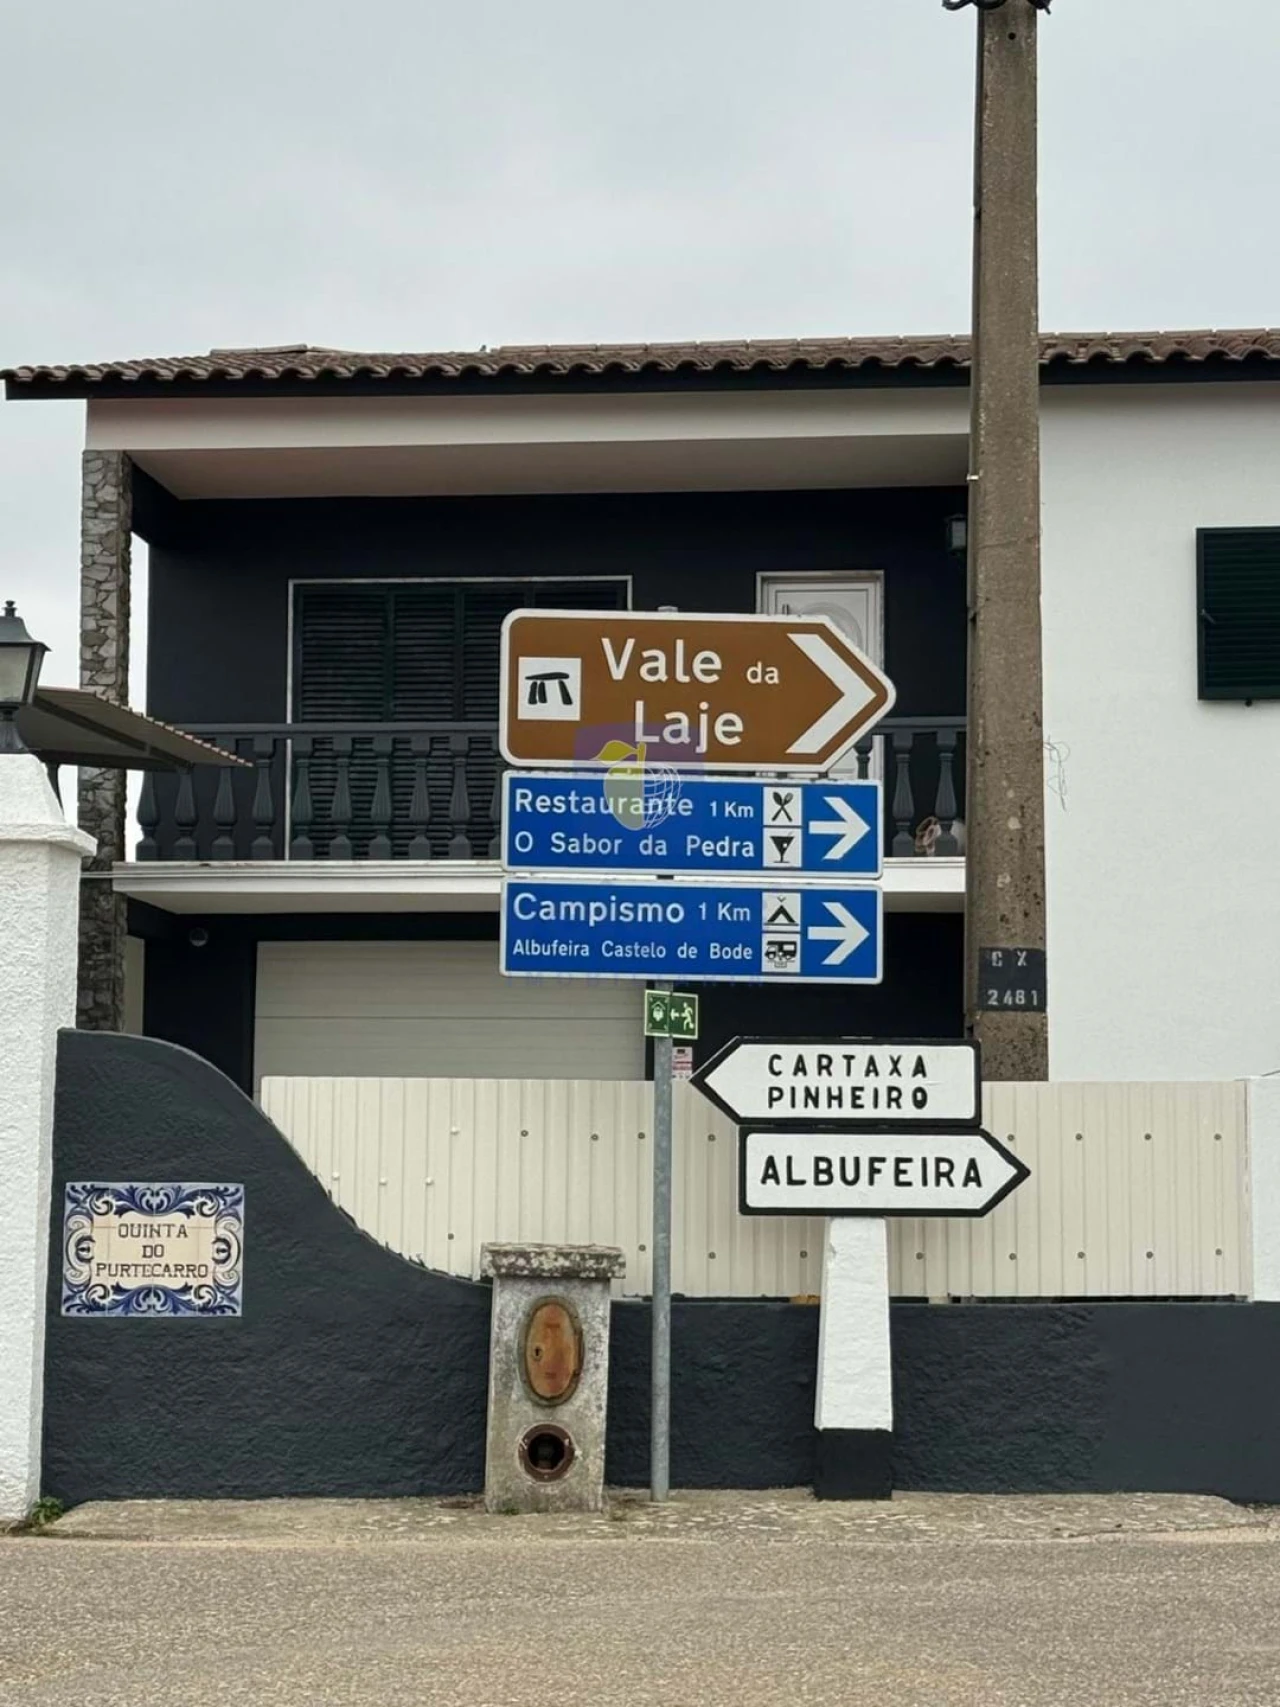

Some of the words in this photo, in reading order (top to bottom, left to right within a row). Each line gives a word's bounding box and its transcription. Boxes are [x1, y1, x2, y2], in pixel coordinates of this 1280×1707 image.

[601, 637, 723, 684] Vale
[746, 661, 780, 684] da
[634, 700, 744, 754] Laje
[514, 788, 694, 816] Restaurante
[709, 801, 718, 818] 1
[724, 802, 754, 819] Km
[514, 831, 533, 852] O
[550, 832, 623, 855] Sabor
[639, 834, 667, 856] da
[685, 836, 756, 858] Pedra
[513, 892, 685, 927] Campismo
[698, 903, 708, 921] 1
[717, 904, 752, 922] Km
[512, 939, 590, 958] Albufeira
[601, 942, 667, 958] Castelo
[677, 944, 698, 959] de
[709, 944, 753, 960] Bode
[987, 989, 1038, 1006] 2481
[768, 1053, 927, 1078] CARTAXA
[767, 1086, 928, 1110] PINHEIRO
[760, 1155, 983, 1188] ALBUFEIRA
[141, 1244, 165, 1258] DO
[95, 1263, 209, 1279] PURTECARRO
